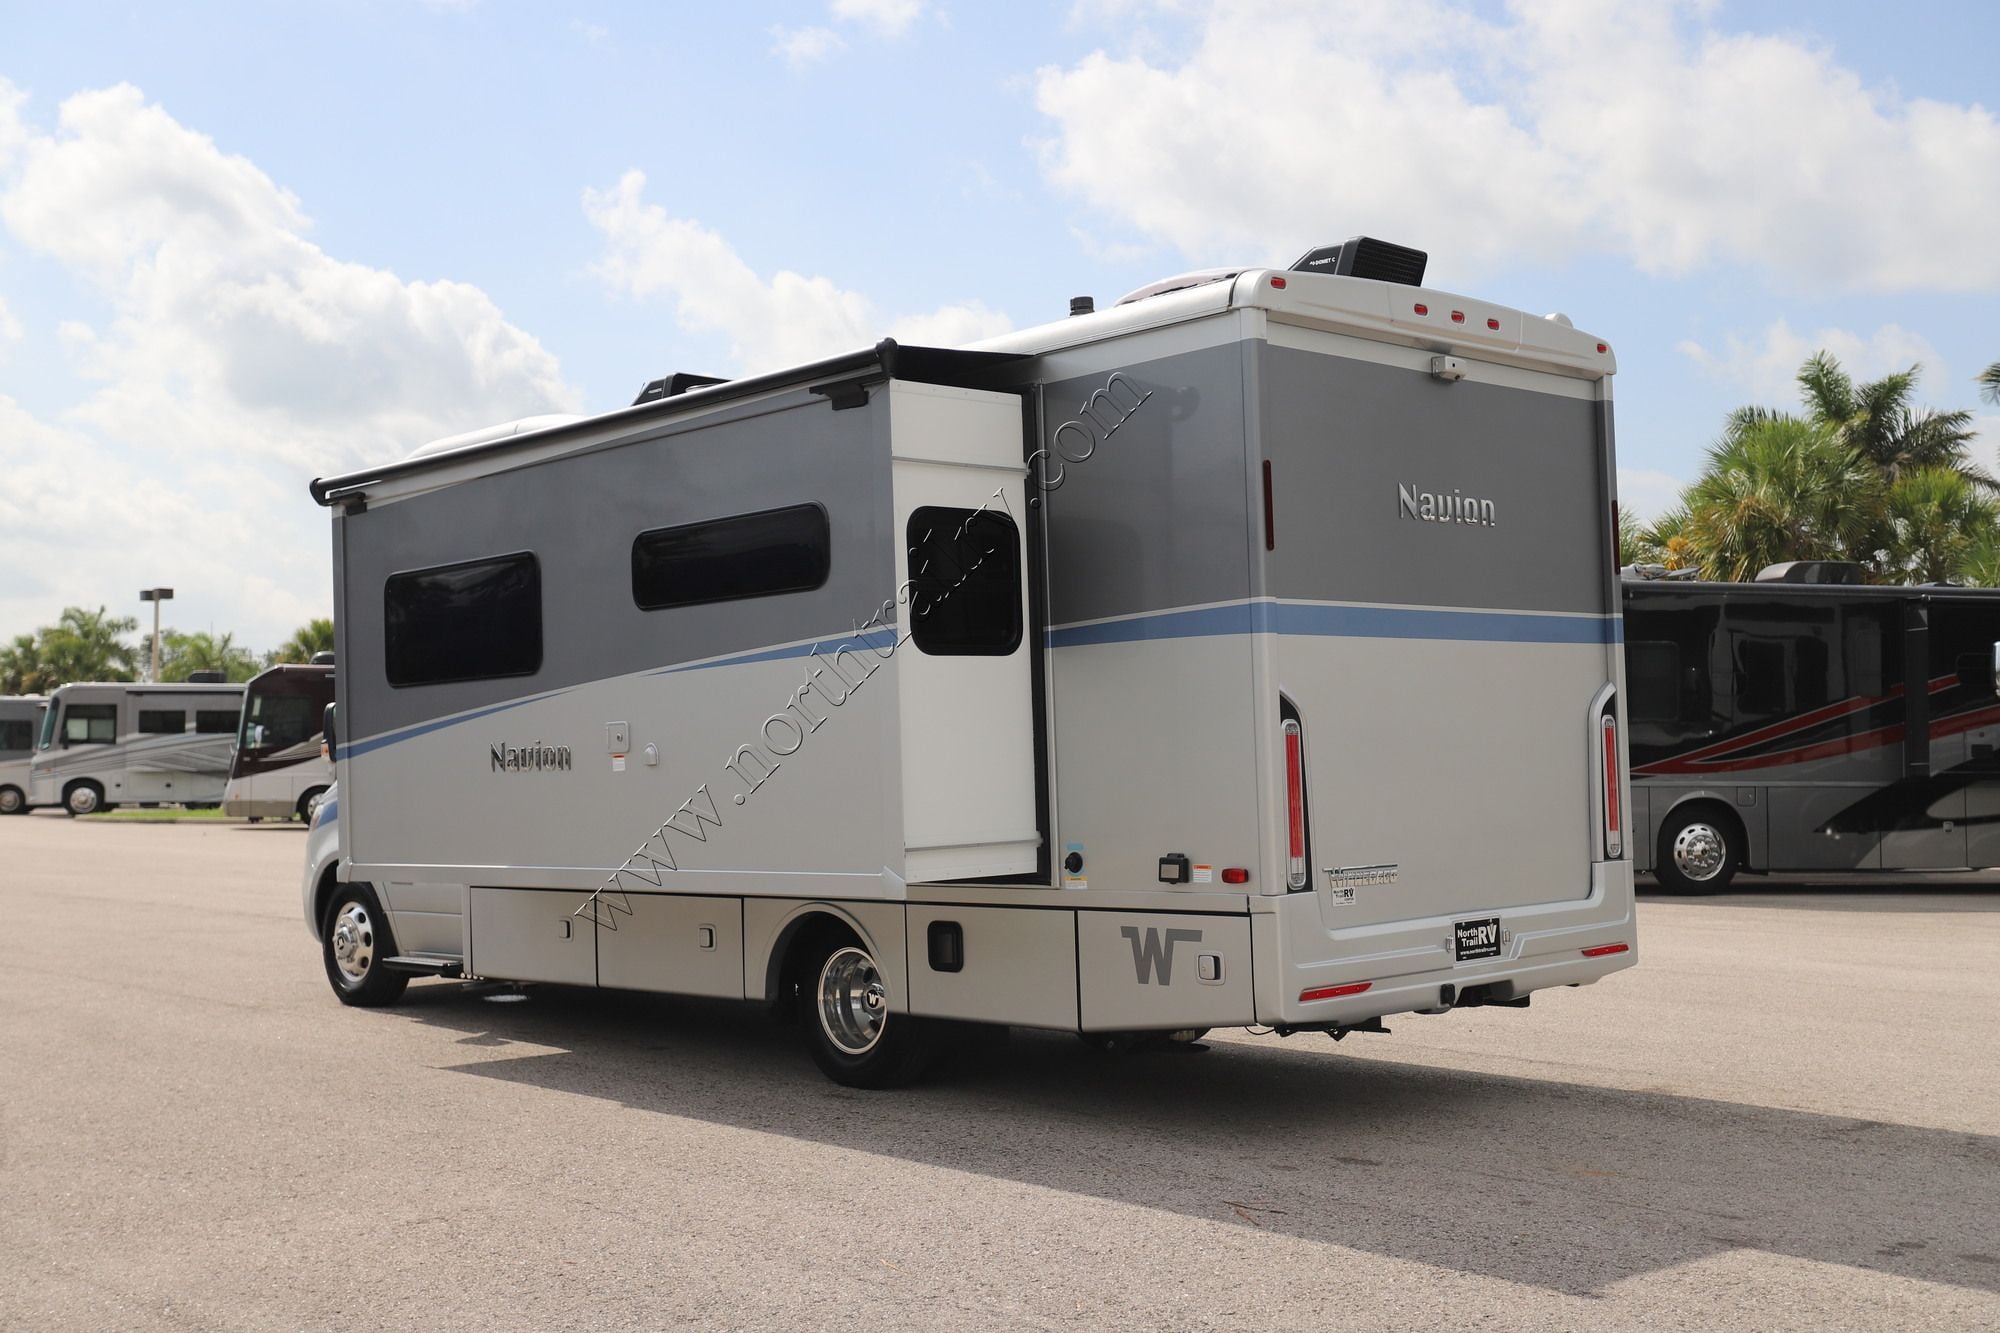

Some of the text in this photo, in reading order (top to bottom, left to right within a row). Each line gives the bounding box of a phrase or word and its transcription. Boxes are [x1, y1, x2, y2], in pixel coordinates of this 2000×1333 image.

[1315, 257, 1336, 266] DOMETC
[1344, 888, 1354, 898] RV
[1457, 927, 1478, 938] North
[1478, 923, 1497, 945] RV
[1461, 937, 1478, 947] Trail
[1120, 926, 1202, 986] W
